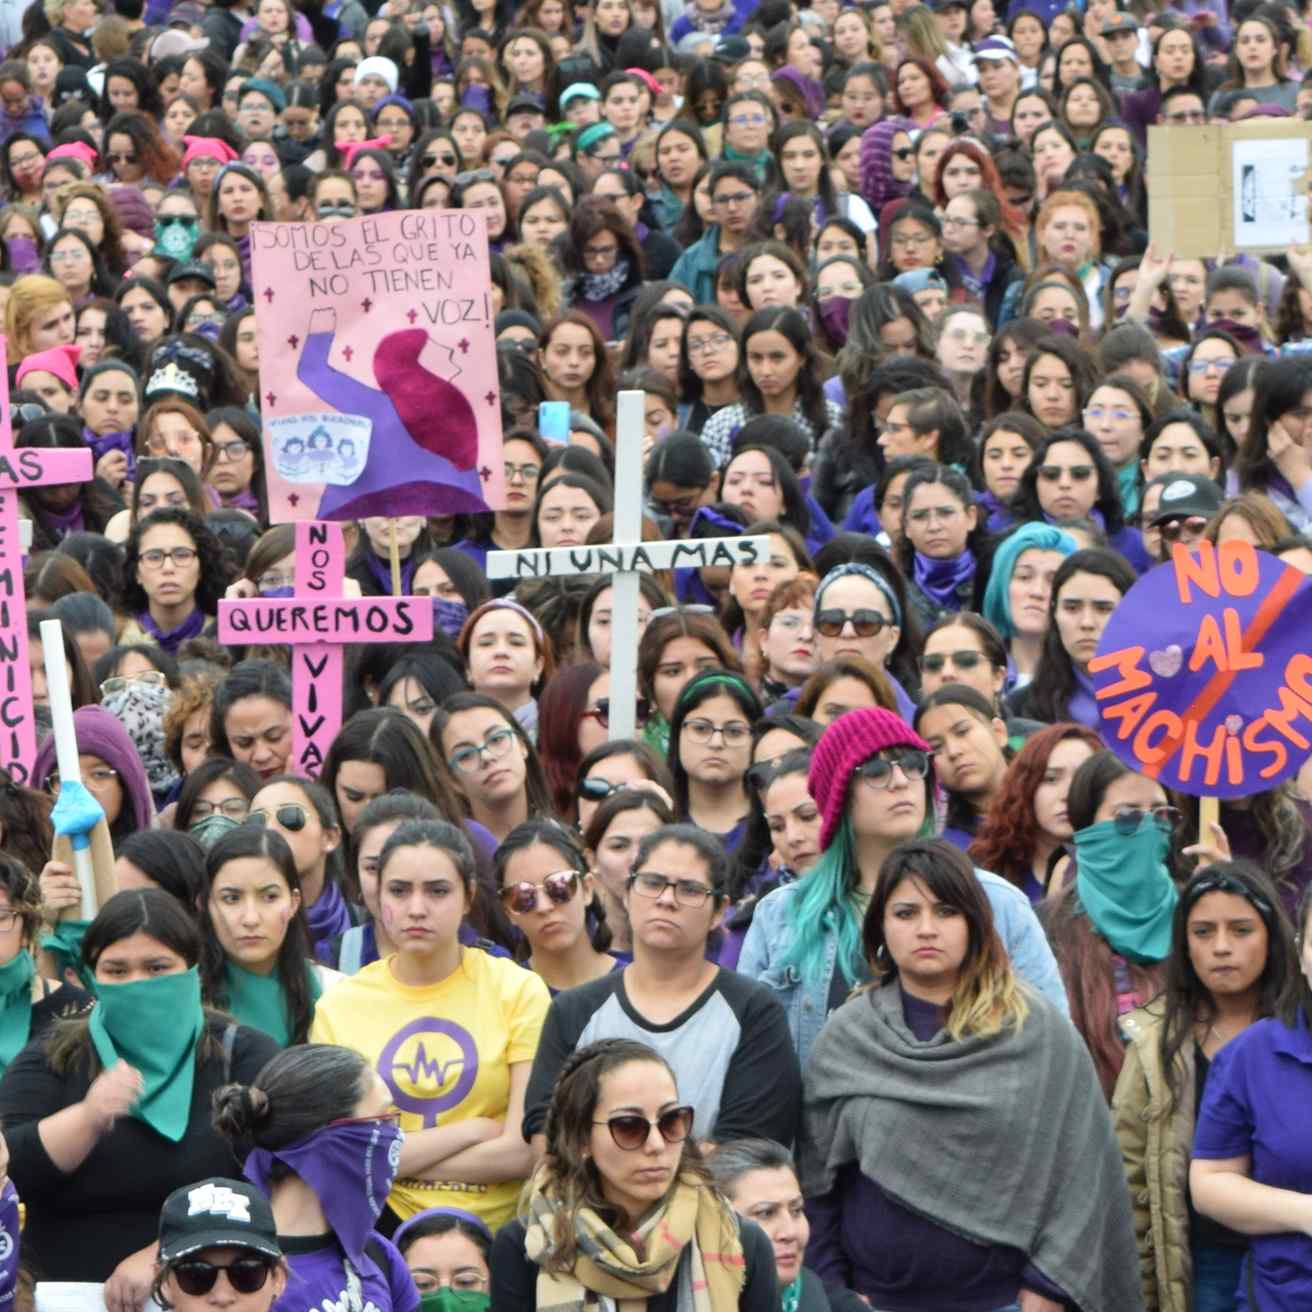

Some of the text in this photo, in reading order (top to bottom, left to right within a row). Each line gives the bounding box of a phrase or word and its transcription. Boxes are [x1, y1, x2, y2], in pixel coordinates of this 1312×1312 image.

[361, 221, 390, 245] EL
[401, 214, 476, 241] GRITO
[331, 246, 382, 270] LAS
[393, 242, 438, 263] QUE
[450, 242, 477, 261] YA
[309, 268, 454, 297] NO TIENEN
[422, 292, 490, 328] VOZ!
[307, 523, 330, 591] NOS
[516, 540, 759, 576] NI UNA MAS
[1173, 539, 1261, 604] NO
[230, 601, 414, 635] QUEREMOS
[1189, 607, 1265, 673] AL
[298, 653, 329, 779] VIVAS
